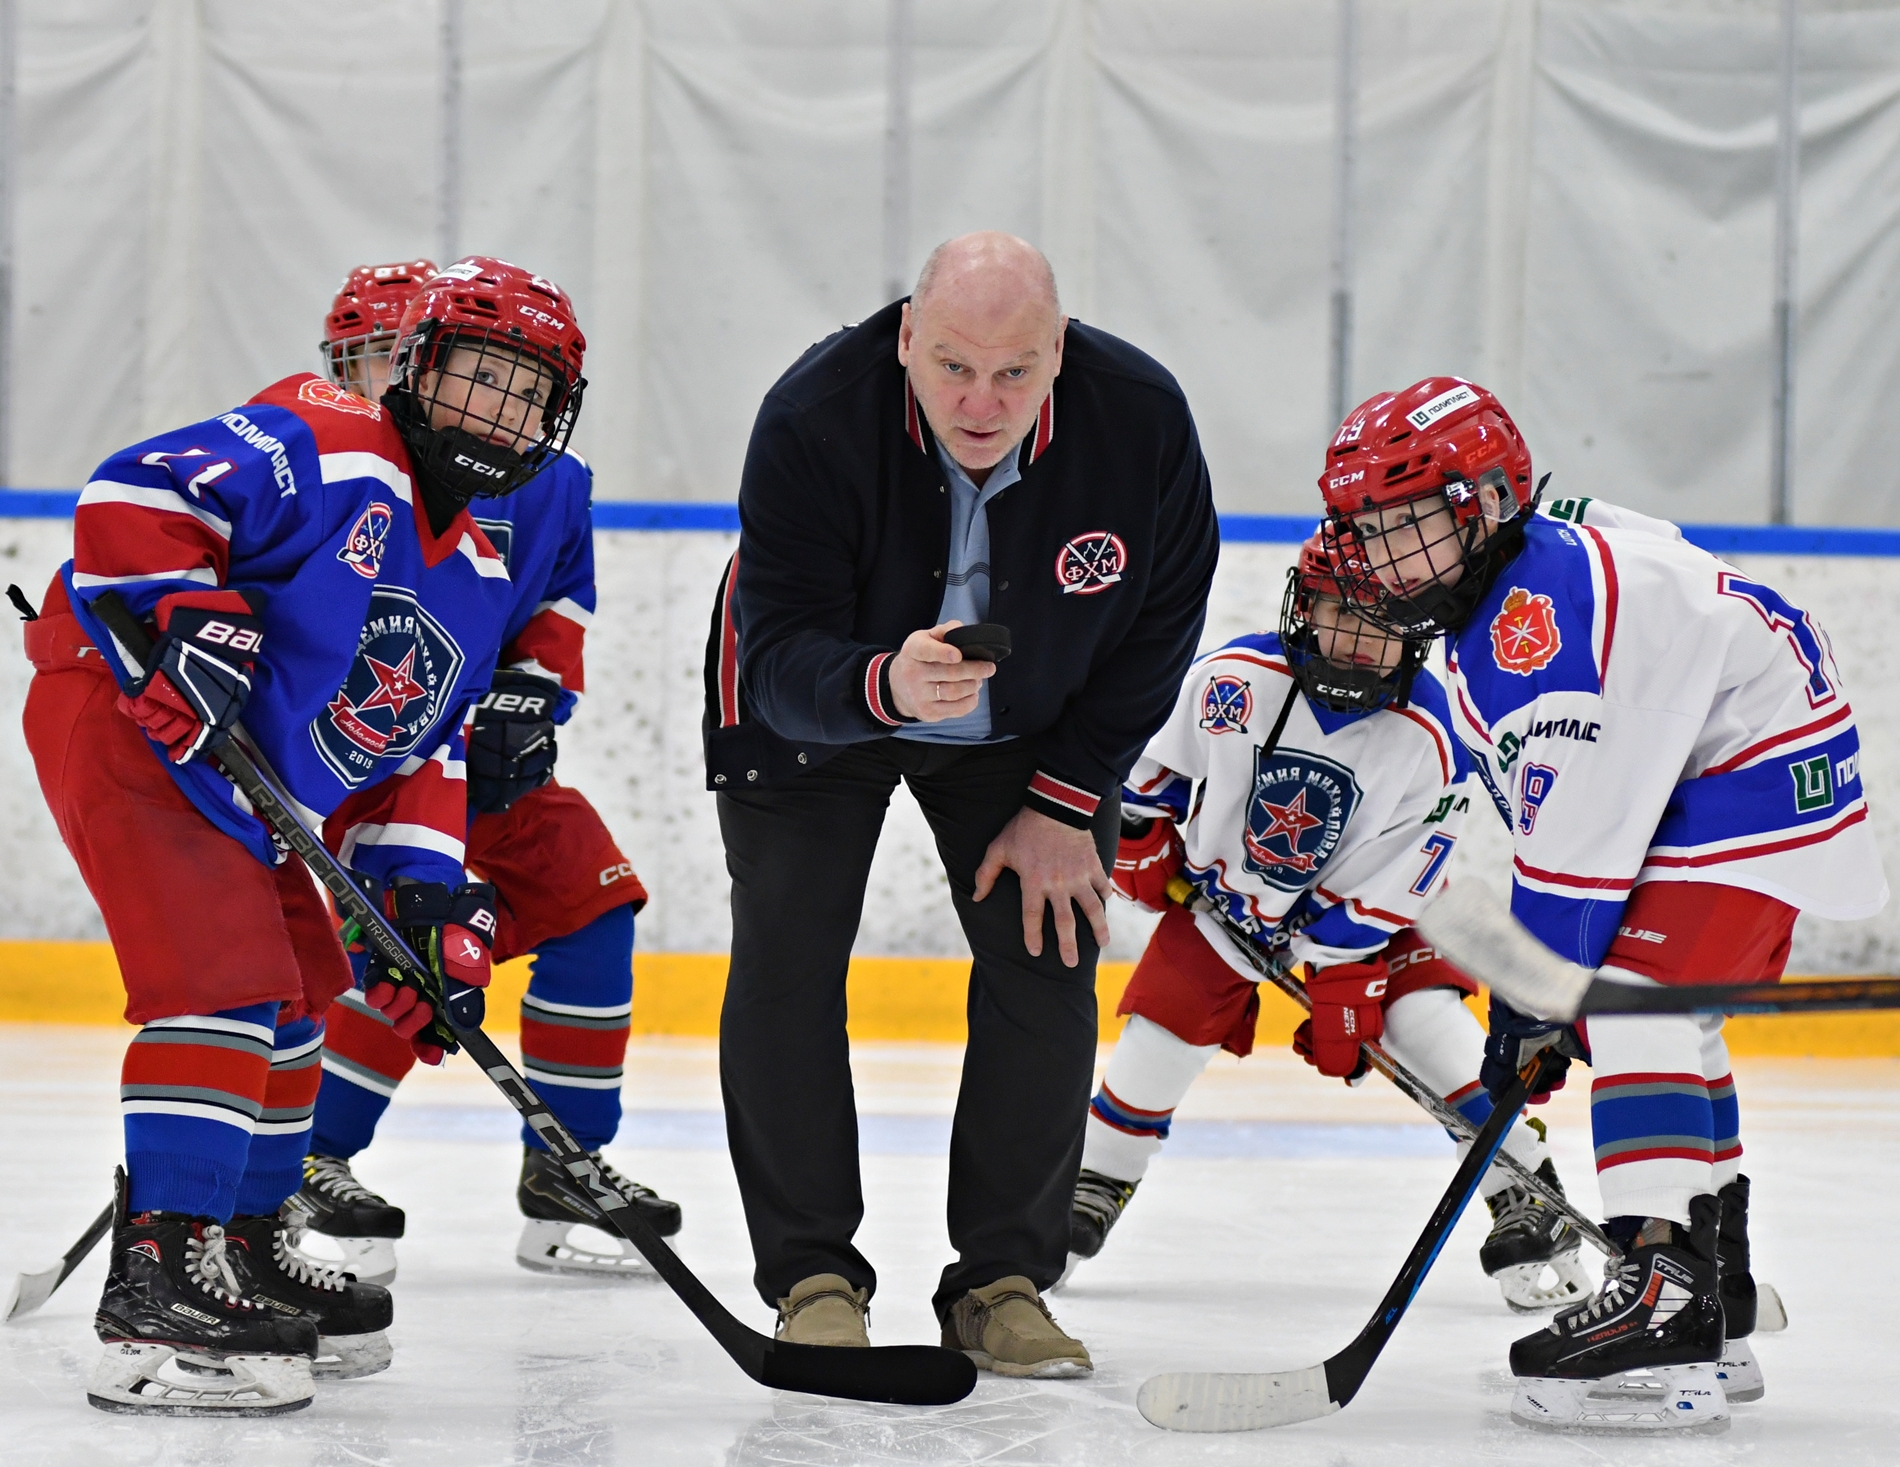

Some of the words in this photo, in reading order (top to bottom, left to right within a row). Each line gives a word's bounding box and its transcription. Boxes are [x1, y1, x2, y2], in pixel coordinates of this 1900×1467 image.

[519, 305, 565, 330] CCM
[1428, 390, 1470, 415] ПОЛИПЛАСТ
[1465, 441, 1498, 464] CCM
[454, 453, 505, 479] CCM
[1329, 470, 1365, 489] CCM
[1065, 556, 1118, 581] ФХМ
[1316, 683, 1363, 699] CCM
[1206, 704, 1243, 721] ФХМ
[250, 784, 368, 919] RIBCOR
[1409, 831, 1457, 897] 7
[366, 917, 412, 971] TRIGGER
[487, 1064, 630, 1213] CCM
[1656, 1260, 1694, 1285] TRUE
[174, 1303, 217, 1325] BAUER
[254, 1295, 300, 1315] BAUER
